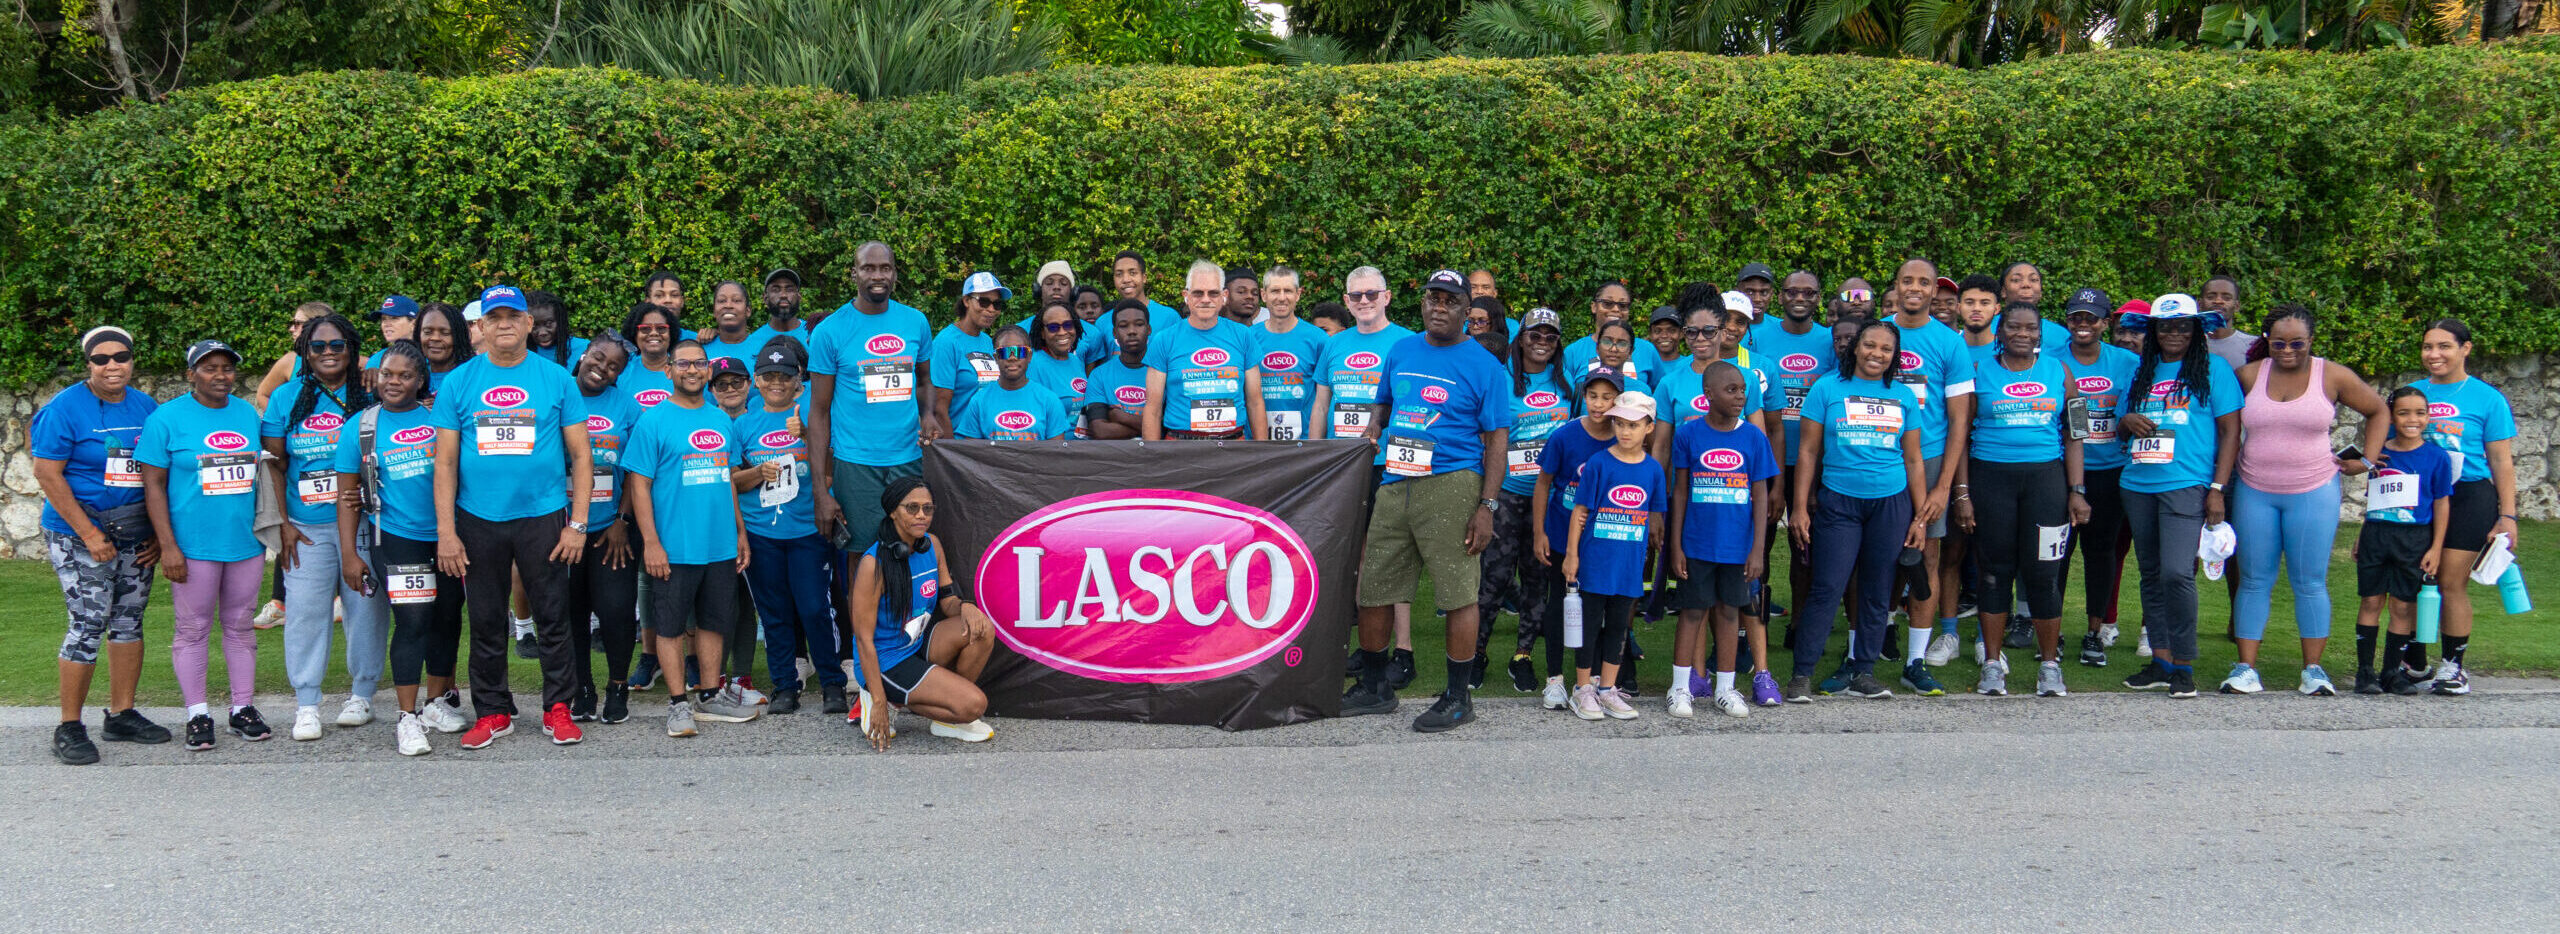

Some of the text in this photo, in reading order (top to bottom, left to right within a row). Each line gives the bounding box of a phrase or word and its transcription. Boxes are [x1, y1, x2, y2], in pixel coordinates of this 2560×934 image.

[1533, 308, 1556, 320] PTY
[872, 340, 901, 351] LASCO
[1197, 352, 1224, 362] LASCO
[1267, 356, 1293, 366] LASCO
[1350, 356, 1375, 365] LASCO
[1786, 358, 1814, 367] LASCO
[1217, 370, 1239, 379] 10K
[1282, 376, 1304, 385] 10K
[882, 375, 901, 388] 79
[2078, 379, 2109, 389] LASCO
[1119, 389, 1145, 399] LASCO
[1423, 388, 1447, 401] LASCO
[2010, 385, 2040, 394] LASCO
[489, 391, 521, 403] LASCO
[639, 392, 667, 403] LASCO
[1529, 395, 1555, 405] LASCO
[1866, 404, 1885, 415] 50
[1992, 402, 2057, 411] ANNUAL 10K
[1001, 416, 1030, 425] LASCO
[1206, 409, 1223, 421] 87
[1344, 413, 1360, 425] 88
[1519, 414, 1548, 424] ANNUAL
[308, 416, 339, 428] LASCO
[588, 419, 608, 428] SCO
[2092, 420, 2109, 432] 58
[398, 429, 431, 442] LASCO
[495, 427, 516, 441] 98
[1267, 426, 1294, 440] 165
[2435, 424, 2464, 437] 10K
[211, 434, 243, 447] LASCO
[594, 438, 620, 449] 10K
[694, 434, 721, 445] LASCO
[2138, 439, 2160, 451] 104
[385, 450, 424, 464] ANNUAL
[1398, 448, 1415, 463] 33
[1707, 454, 1738, 465] LASCO
[126, 459, 144, 473] 86
[217, 466, 246, 481] 110
[313, 478, 331, 493] 57
[1693, 477, 1749, 488] ANNUAL 10K
[2380, 482, 2403, 494] 0159
[1615, 490, 1643, 503] LASCO
[1596, 513, 1648, 526] ANNUAL 10K
[405, 576, 425, 589] 55
[1012, 540, 1295, 630] LASCO
